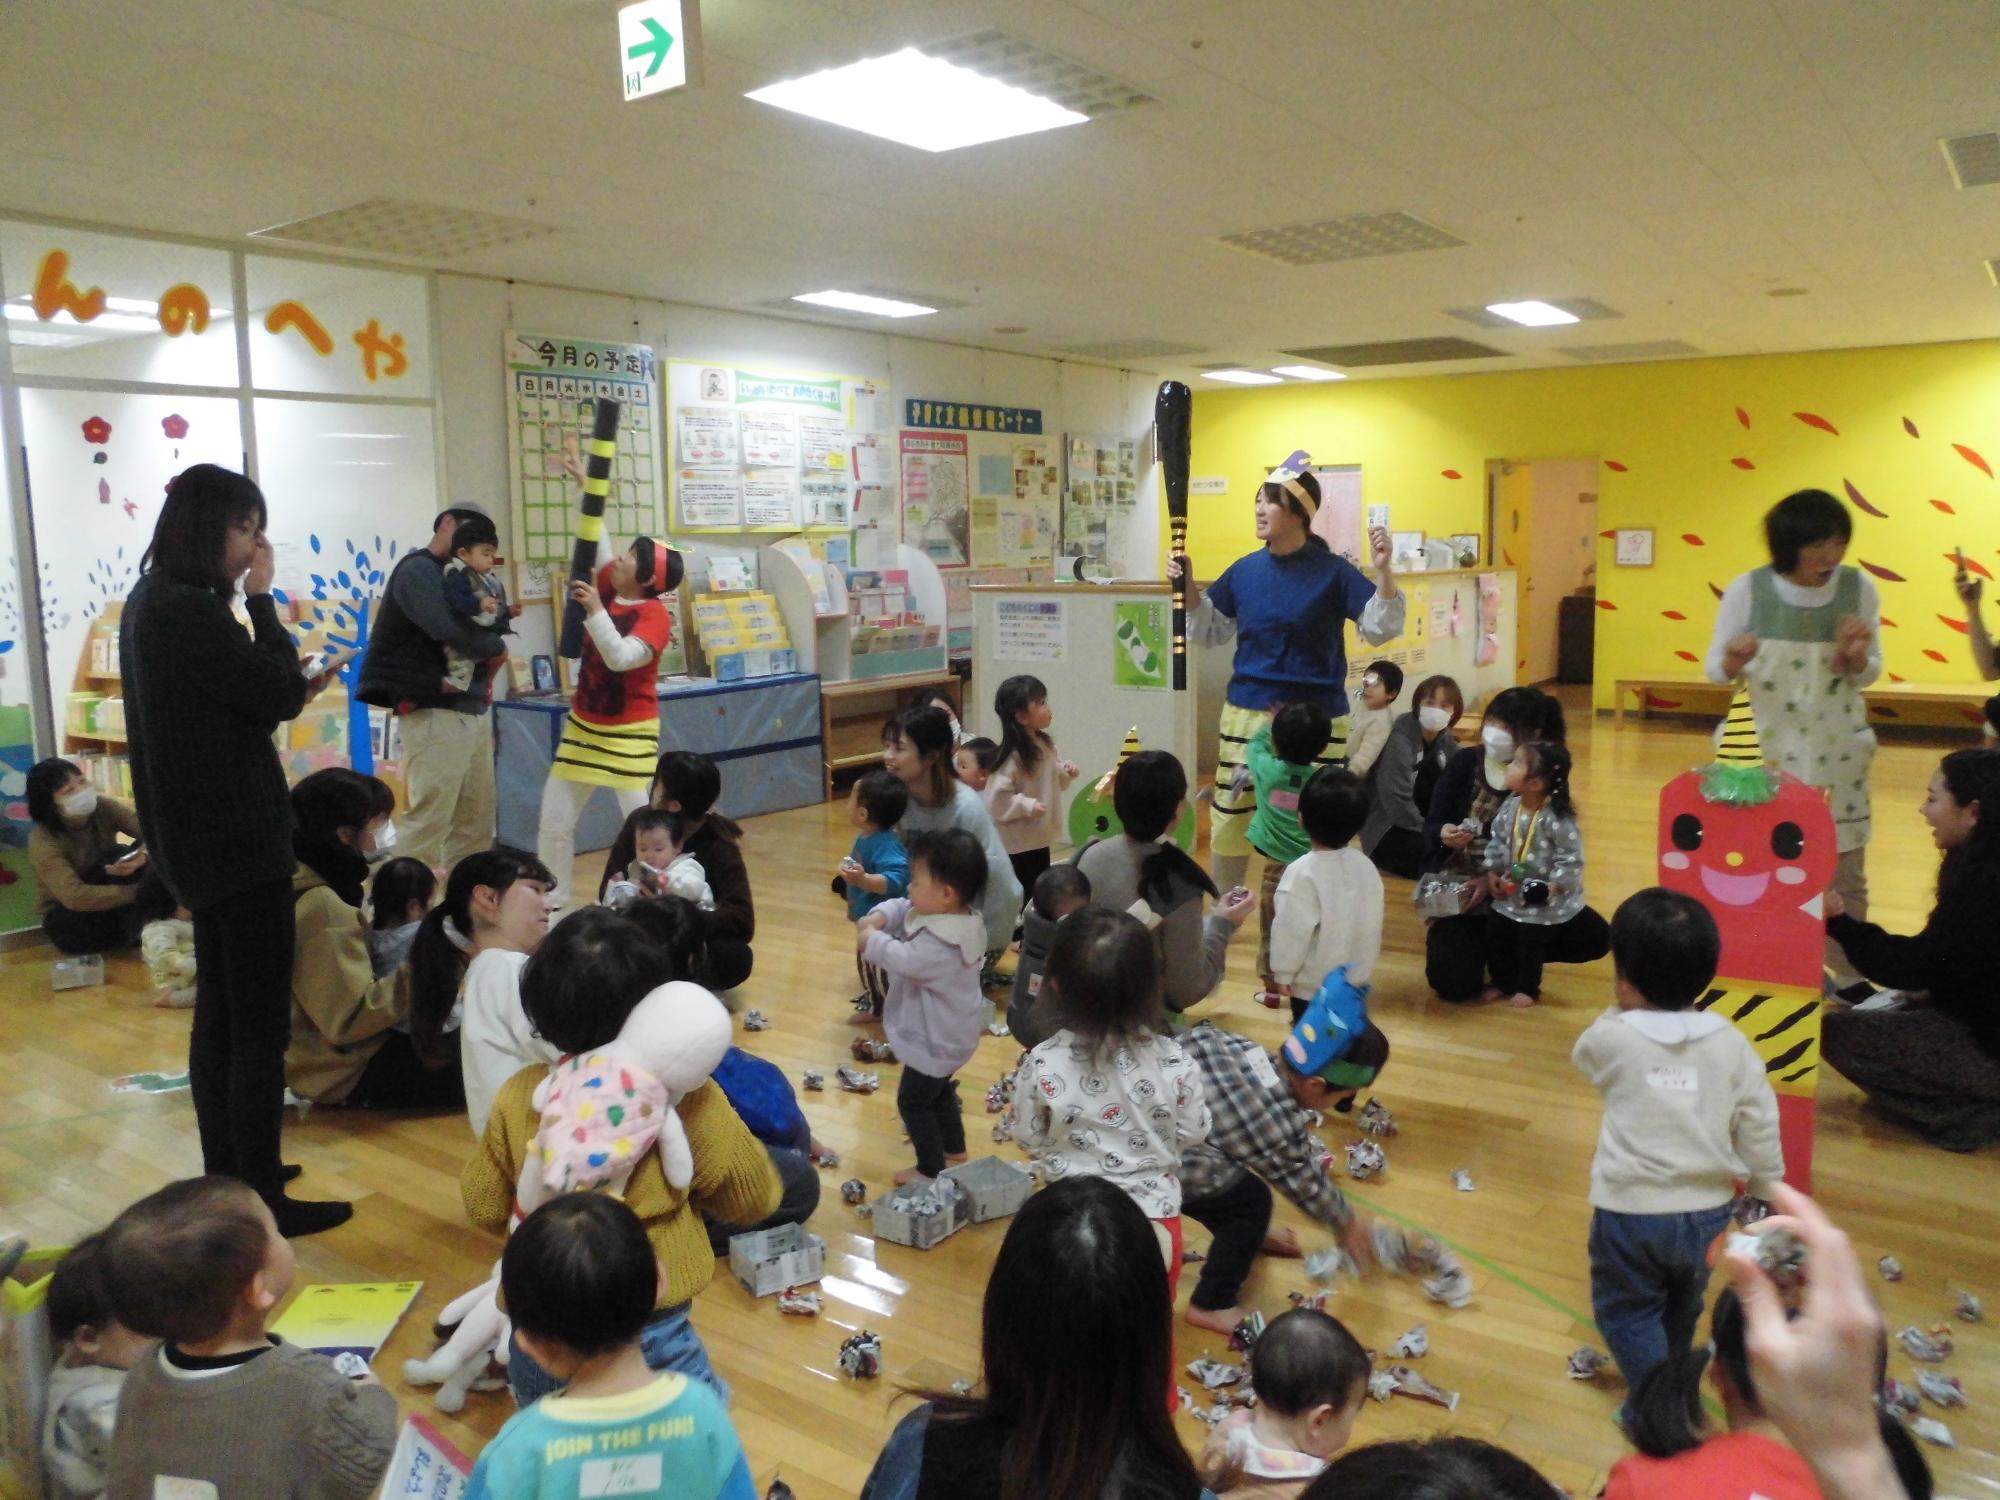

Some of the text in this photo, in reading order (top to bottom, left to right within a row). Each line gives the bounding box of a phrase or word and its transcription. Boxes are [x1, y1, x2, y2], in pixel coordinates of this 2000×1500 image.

[34, 248, 409, 382] んのへや
[537, 340, 641, 375] 今月の予定
[546, 1433, 593, 1467] JOIN
[600, 1426, 642, 1451] THE
